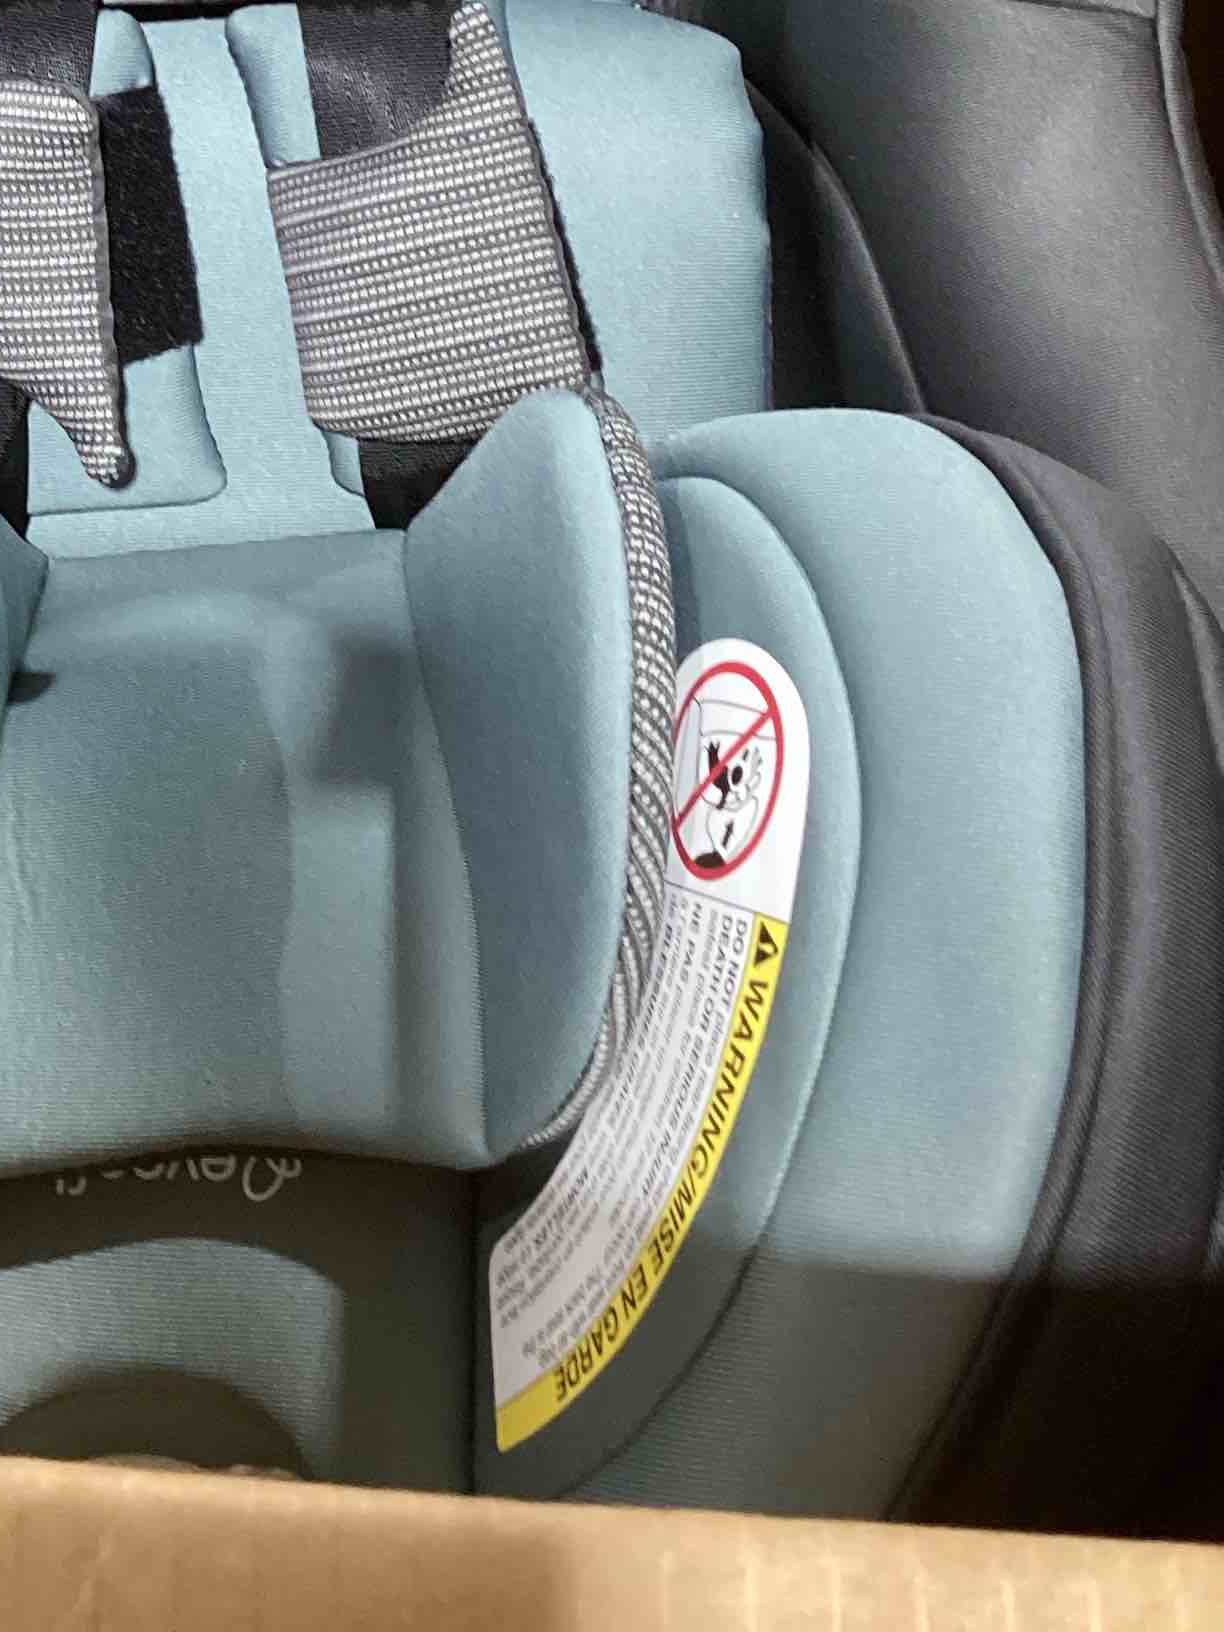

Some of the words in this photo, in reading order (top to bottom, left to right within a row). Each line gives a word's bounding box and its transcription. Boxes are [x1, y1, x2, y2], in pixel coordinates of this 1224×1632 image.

[710, 915, 732, 993] DEATH
[732, 919, 748, 956] DO
[722, 960, 739, 1008] NOT
[700, 998, 714, 1033] OR
[669, 1035, 704, 1132] SERIOUS
[641, 1131, 672, 1196] INJURY
[618, 1266, 648, 1317] EN
[553, 1308, 618, 1402] GARDE
